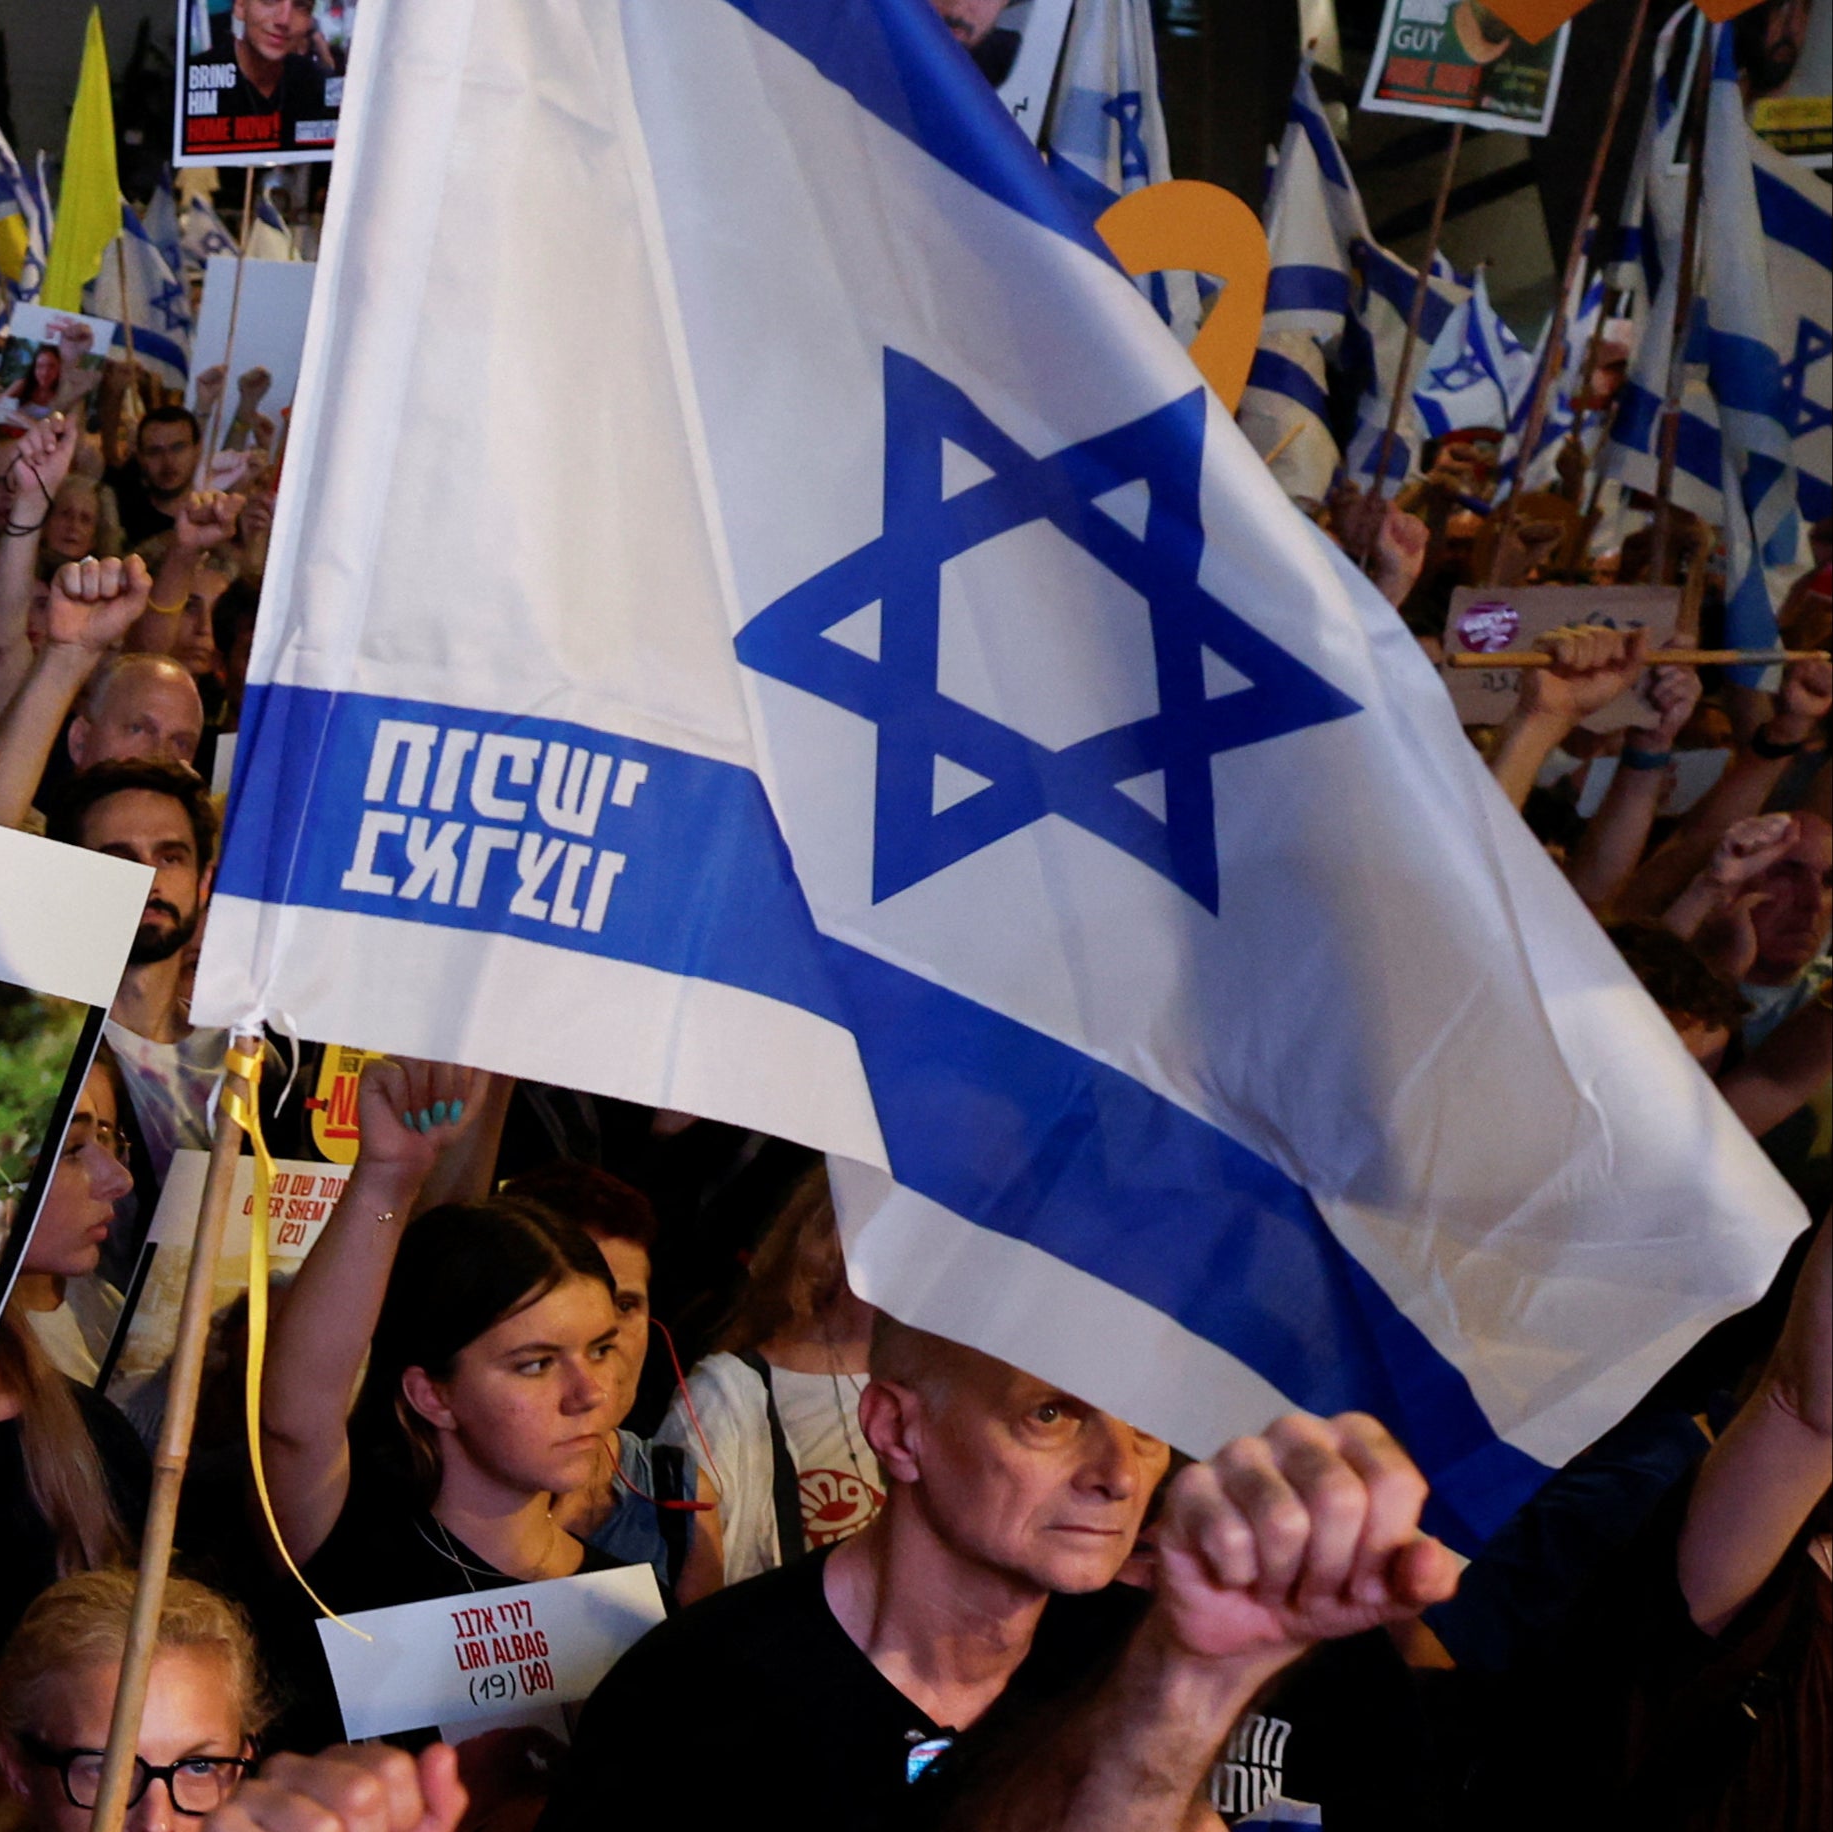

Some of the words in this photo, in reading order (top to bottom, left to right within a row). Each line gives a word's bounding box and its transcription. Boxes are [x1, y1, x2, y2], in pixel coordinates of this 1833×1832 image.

[1393, 25, 1445, 52] GUY
[189, 63, 236, 89] BRING
[188, 90, 218, 116] HIM
[187, 116, 230, 142] HOME
[242, 1196, 284, 1218] OER
[285, 1198, 326, 1222] SHEM
[277, 1222, 307, 1246] (21)
[451, 1607, 498, 1639] אלבג
[496, 1600, 533, 1630] לירי
[454, 1640, 491, 1671] LIRI
[492, 1630, 549, 1664] ALBAG
[469, 1670, 516, 1706] (19)
